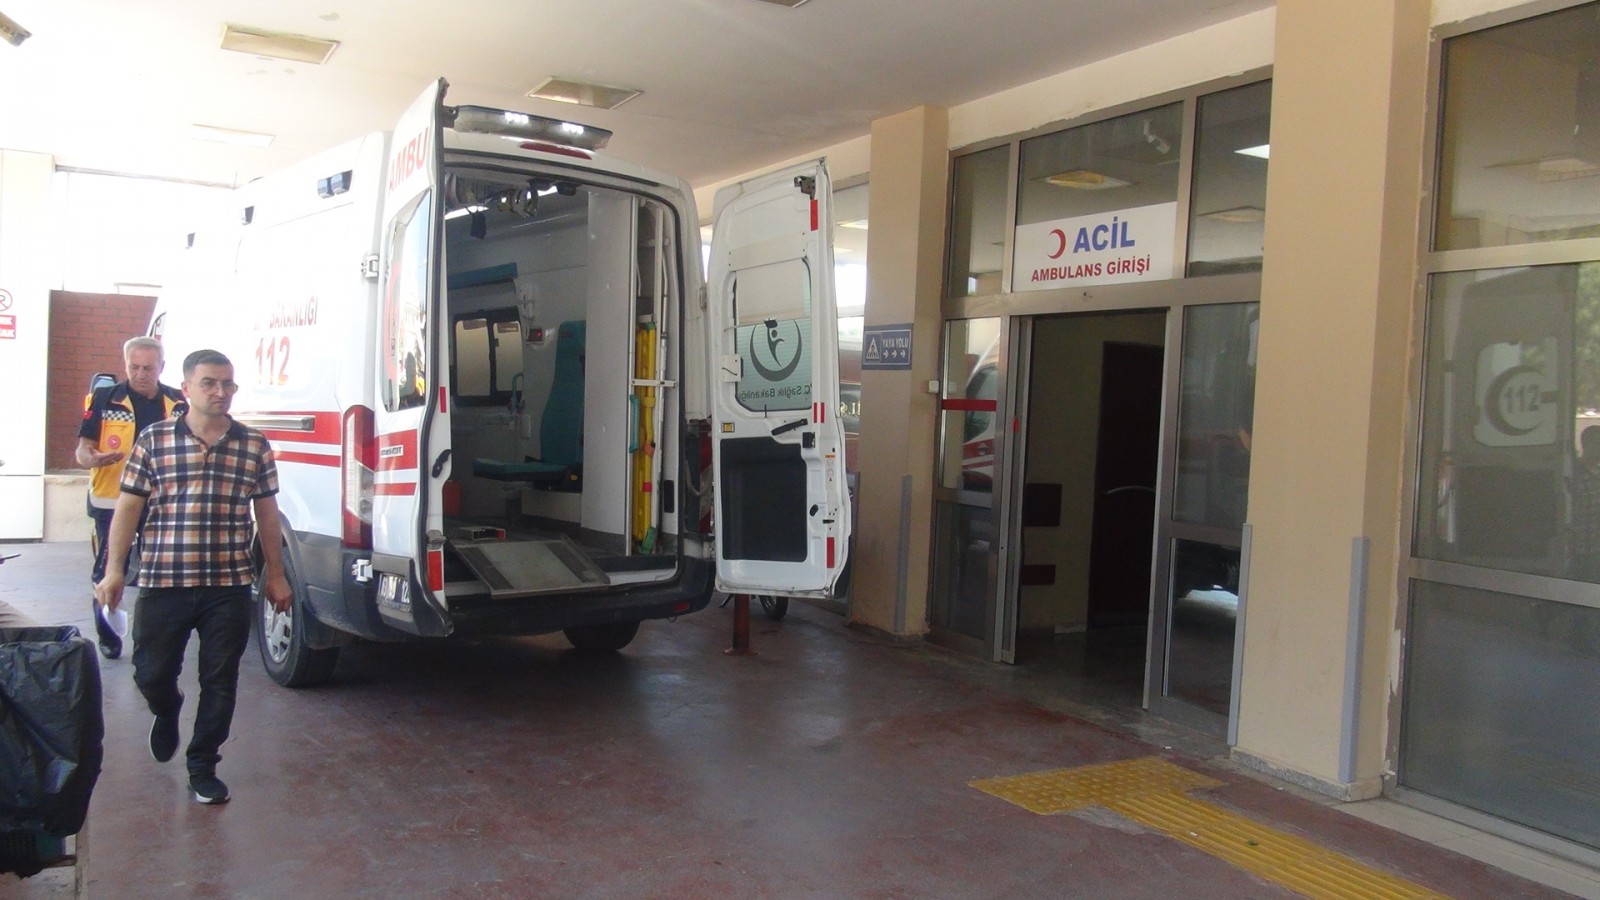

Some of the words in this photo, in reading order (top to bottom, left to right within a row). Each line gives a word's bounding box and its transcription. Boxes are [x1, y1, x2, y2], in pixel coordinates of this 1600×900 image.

[1072, 216, 1136, 254] ACİL
[1031, 263, 1102, 282] AMBULANS
[1106, 254, 1151, 275] GİRİŞİ
[255, 336, 290, 385] 112
[1503, 384, 1540, 413] 112
